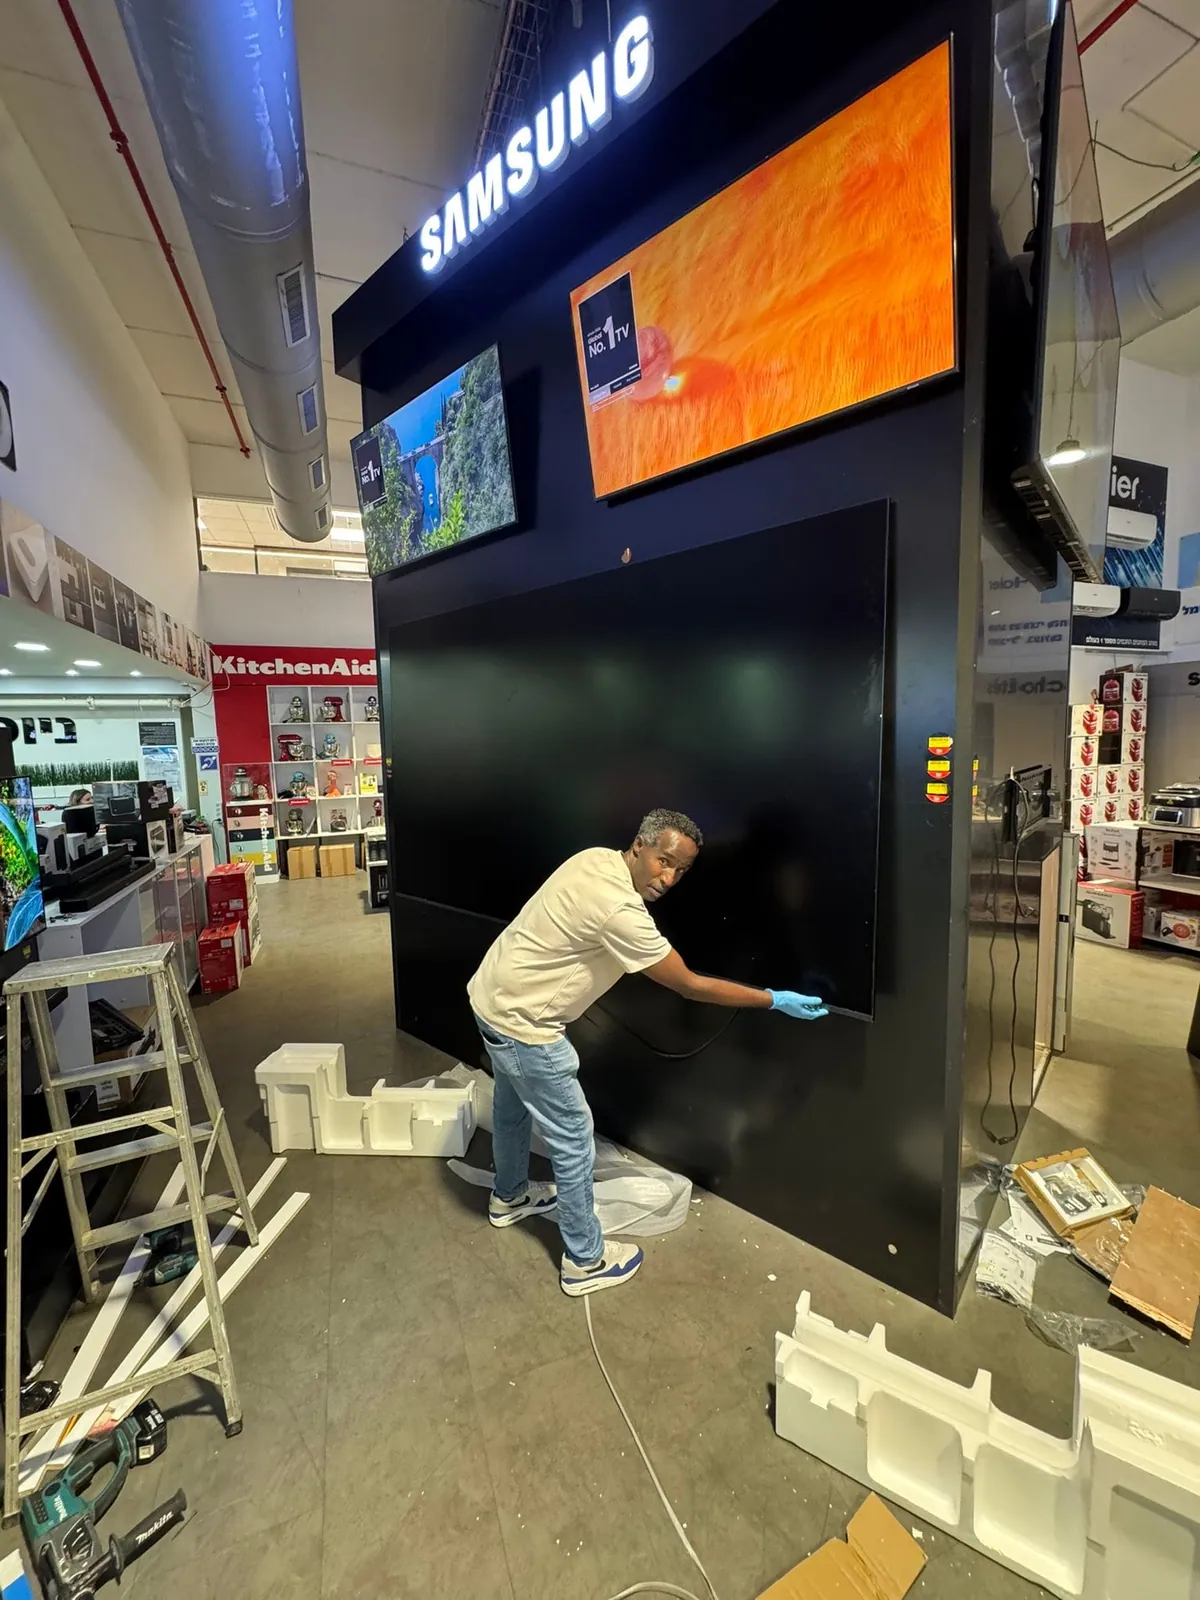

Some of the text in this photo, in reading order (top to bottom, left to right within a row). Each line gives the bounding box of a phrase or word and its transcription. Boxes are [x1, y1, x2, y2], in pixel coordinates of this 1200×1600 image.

[420, 14, 653, 273] SAMSUNG
[602, 315, 616, 350] 1
[614, 322, 630, 342] TV
[212, 655, 377, 676] KitchenAid
[259, 807, 273, 872] KitchenAid
